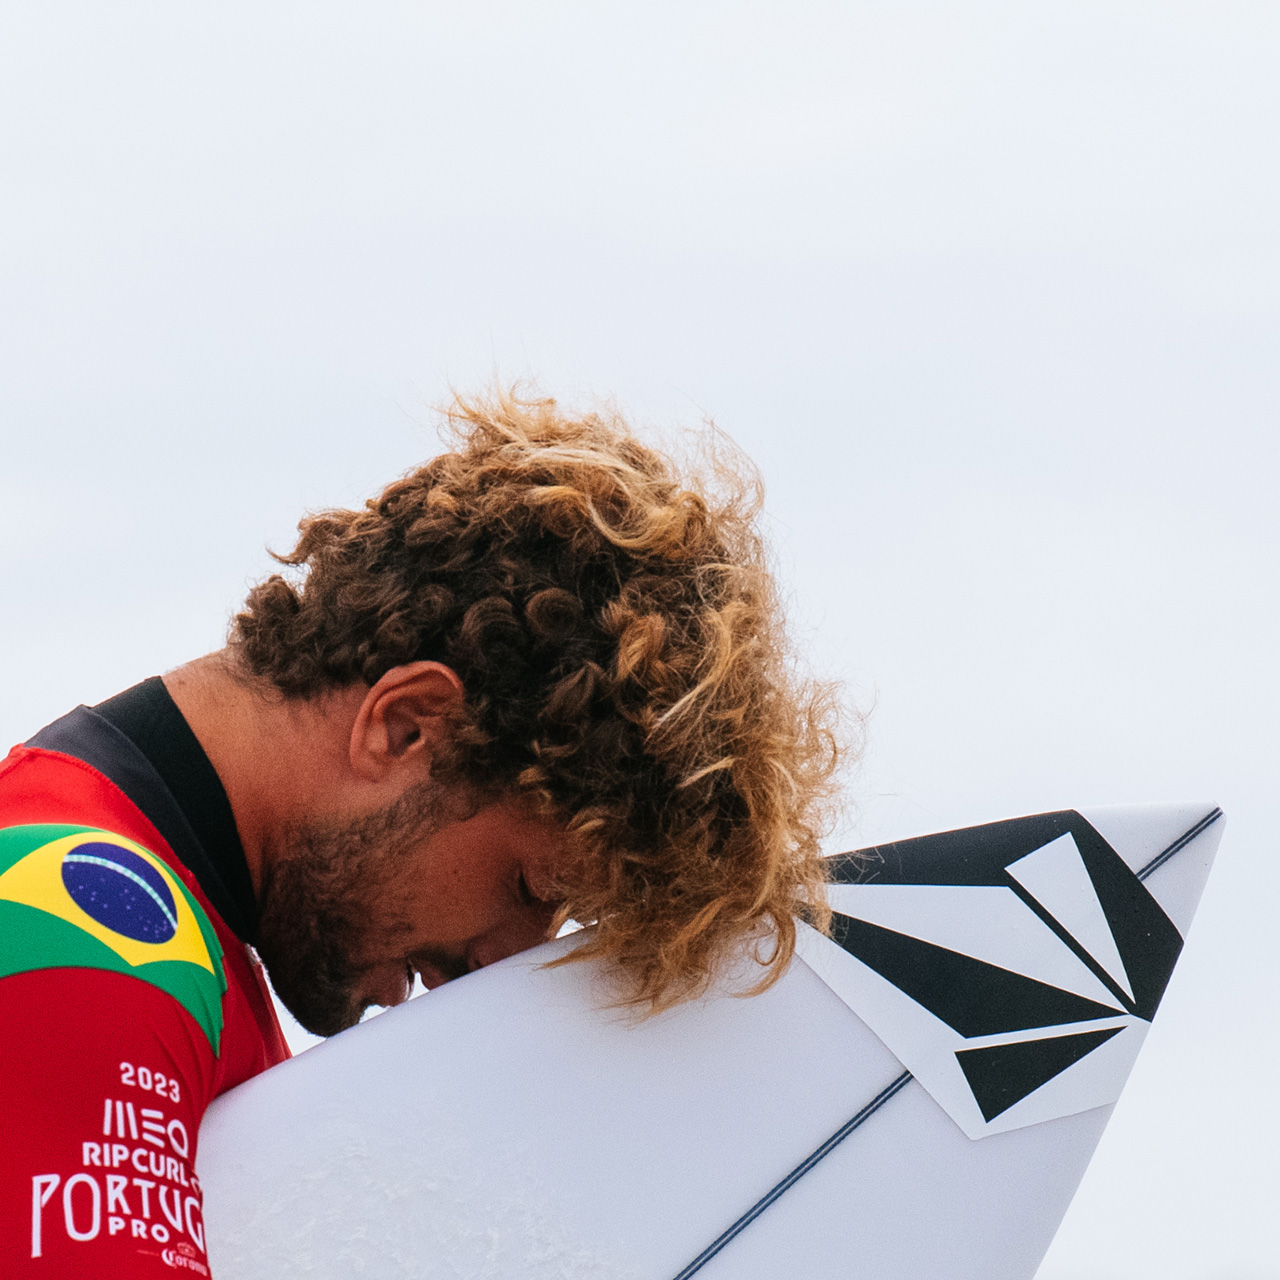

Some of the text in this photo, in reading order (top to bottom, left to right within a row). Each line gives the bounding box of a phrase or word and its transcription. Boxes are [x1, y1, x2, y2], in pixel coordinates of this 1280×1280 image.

[120, 1062, 180, 1103] 2023
[103, 1098, 189, 1159] MEO
[108, 1216, 170, 1243] PRO
